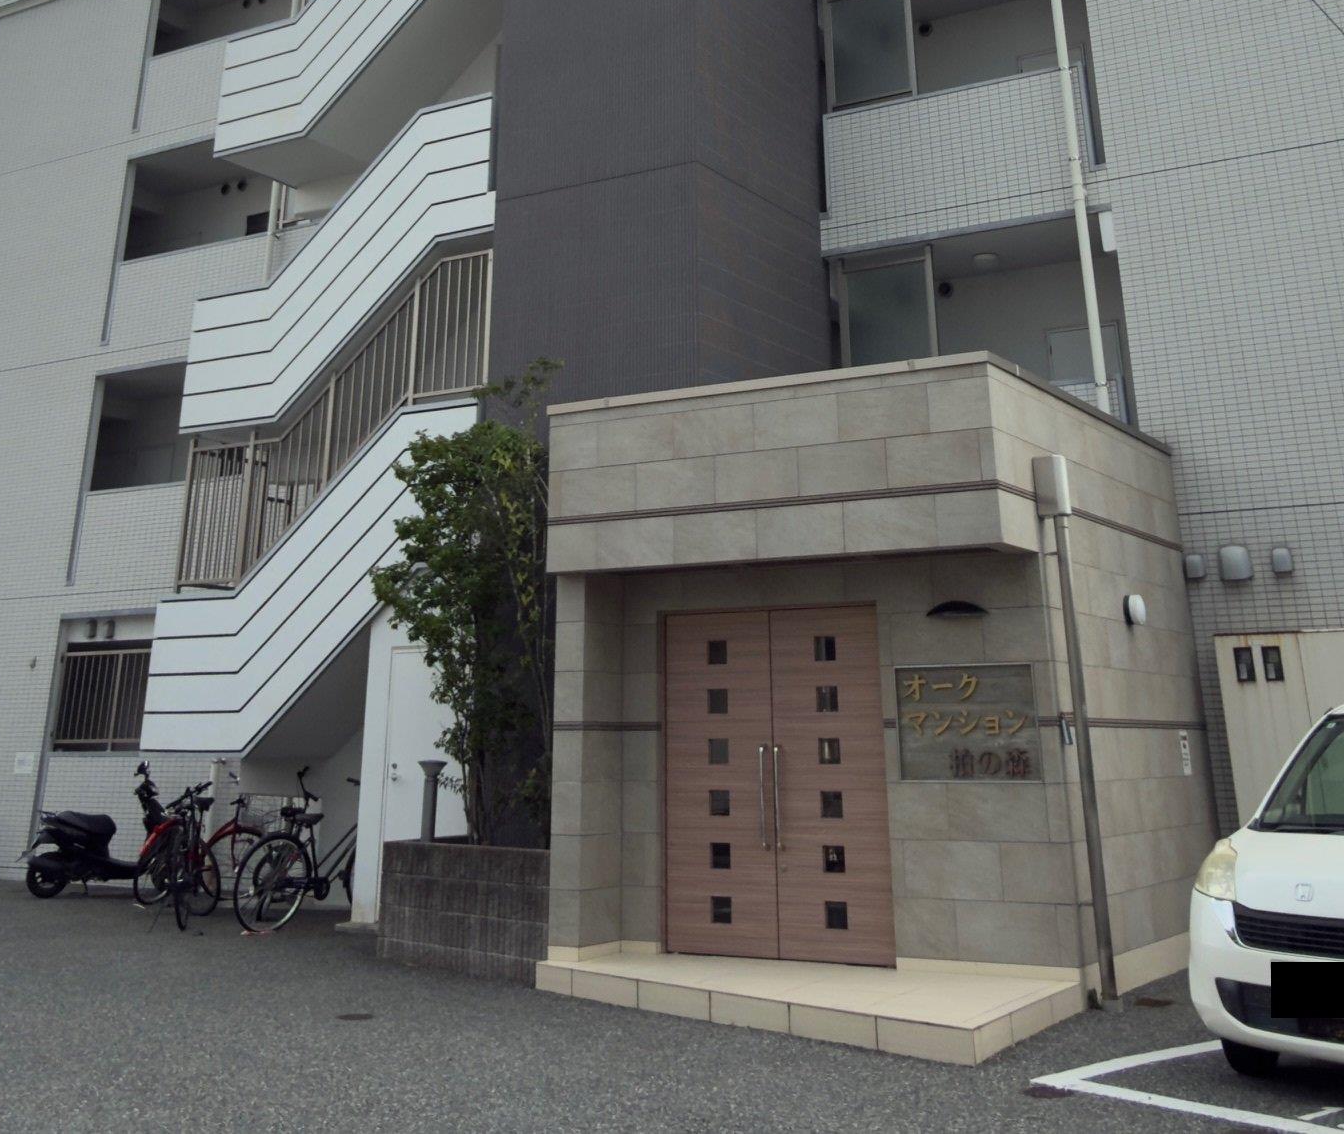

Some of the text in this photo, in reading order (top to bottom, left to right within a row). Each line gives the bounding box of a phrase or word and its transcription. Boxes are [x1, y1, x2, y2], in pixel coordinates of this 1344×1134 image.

[903, 673, 978, 701] オーク
[906, 707, 1029, 736] マンション
